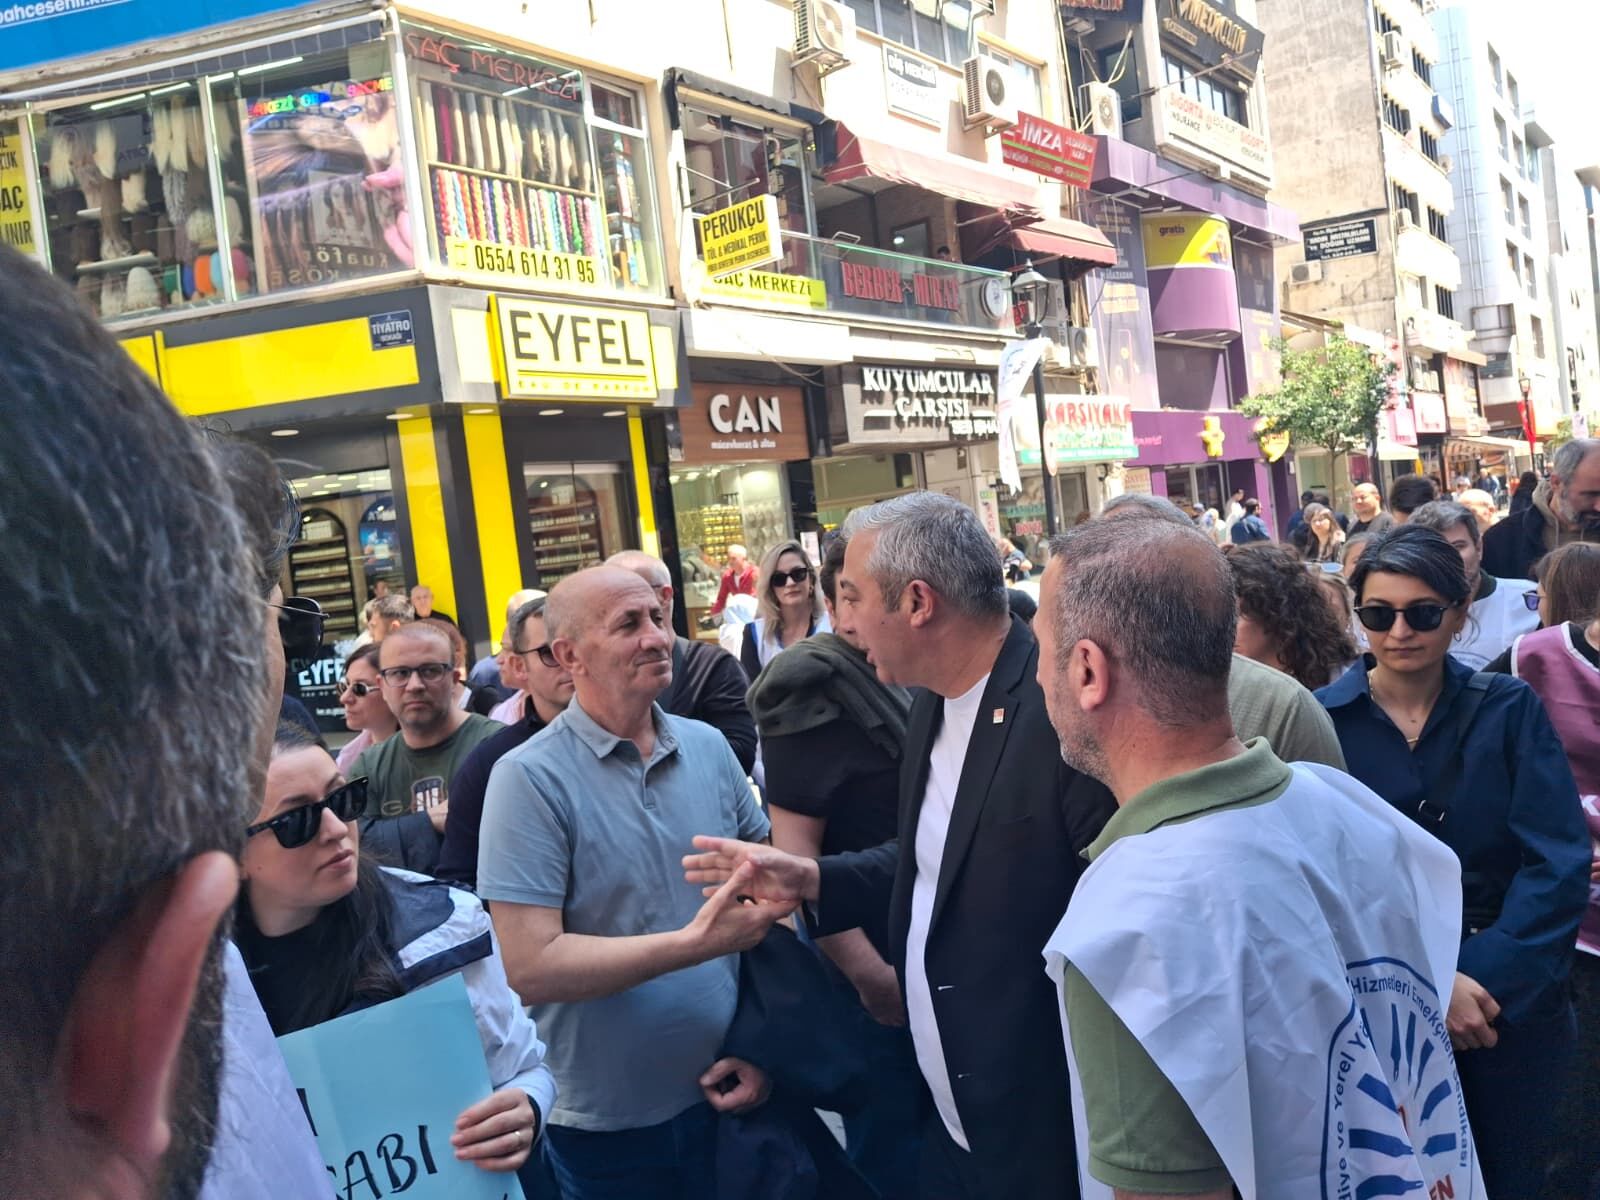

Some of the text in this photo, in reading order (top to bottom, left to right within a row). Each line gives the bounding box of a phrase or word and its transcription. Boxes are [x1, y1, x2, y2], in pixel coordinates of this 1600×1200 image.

[1021, 117, 1063, 153] İMZA
[0, 186, 24, 212] AÇ
[702, 199, 765, 243] PERUKÇU
[1159, 225, 1185, 237] gratis
[474, 244, 595, 283] 0554 614 31 95
[749, 273, 812, 296] MERKEZİ
[371, 319, 410, 335] TİYATRO
[509, 309, 645, 367] EYFEL
[862, 367, 995, 394] KUYUMCULAR
[710, 394, 783, 433] CAN
[895, 397, 970, 422] ÇARŞISI
[1334, 1051, 1356, 1111] Yerel
[1348, 1018, 1371, 1050] Yö
[326, 1124, 438, 1200] ABI
